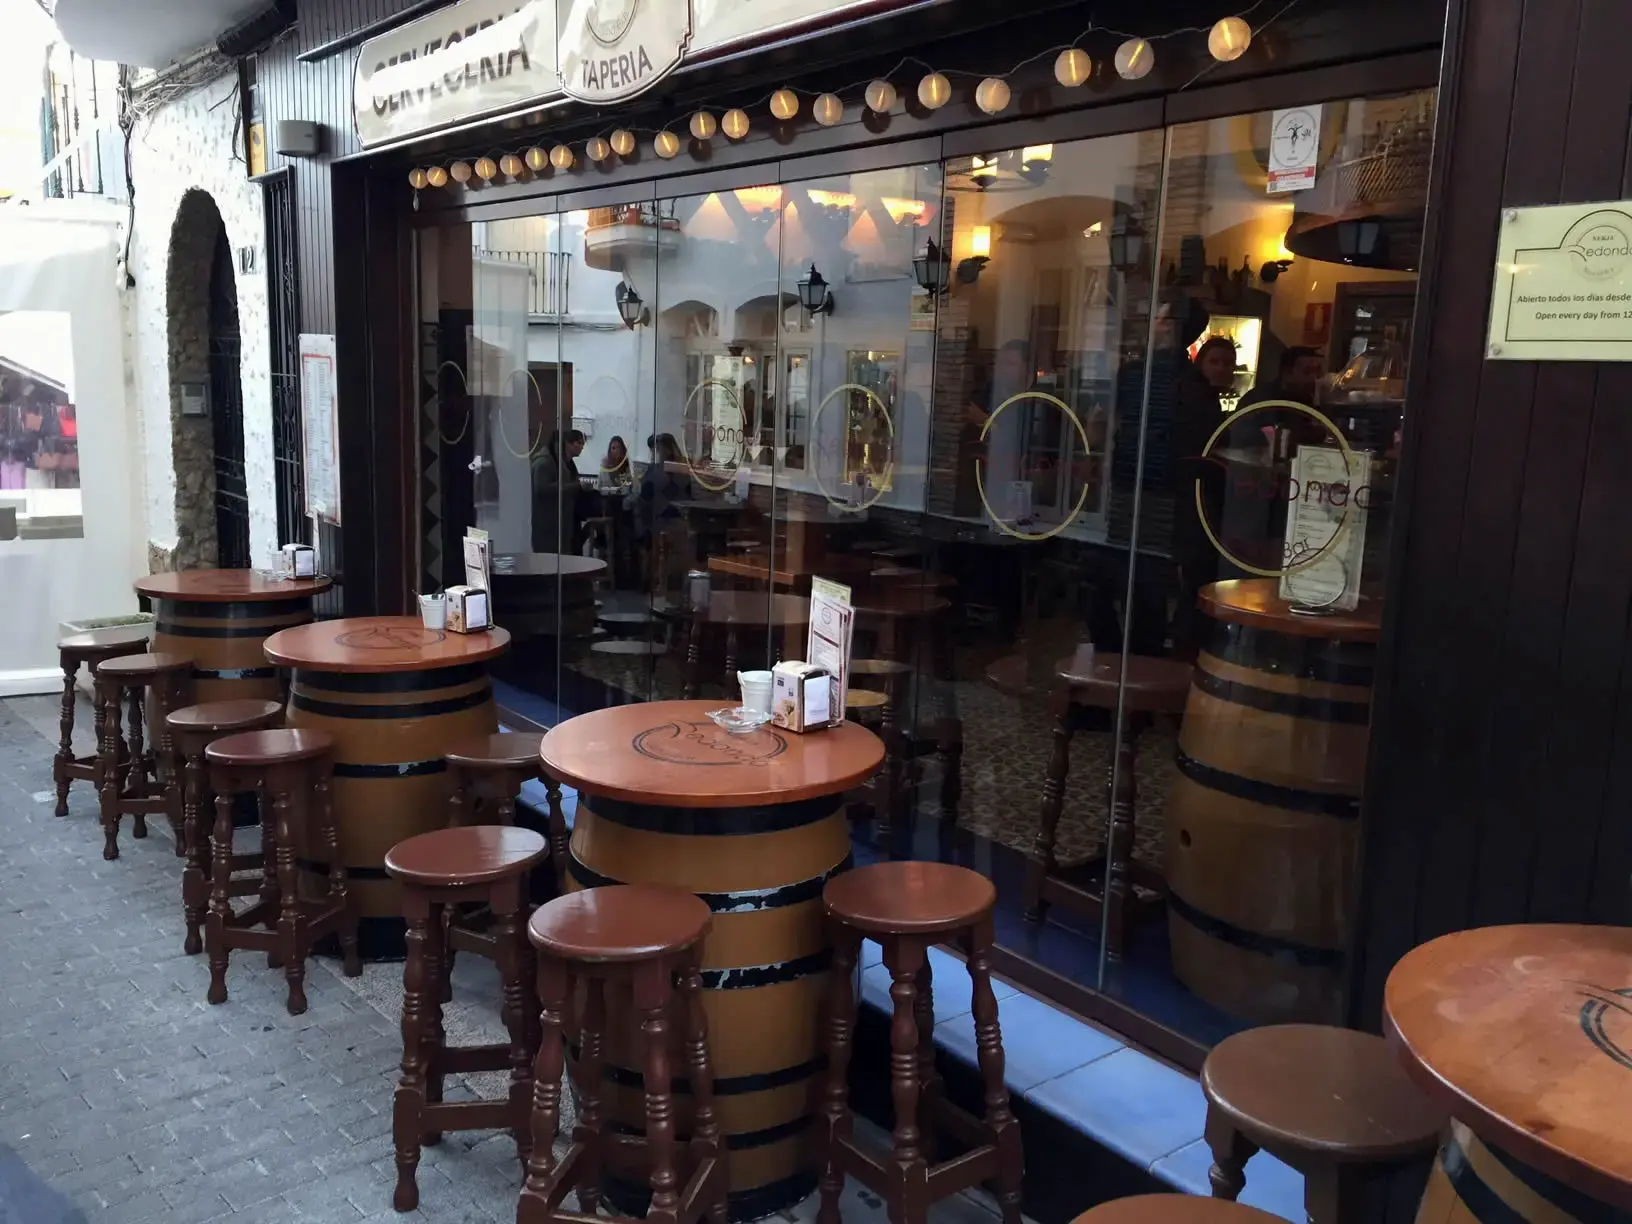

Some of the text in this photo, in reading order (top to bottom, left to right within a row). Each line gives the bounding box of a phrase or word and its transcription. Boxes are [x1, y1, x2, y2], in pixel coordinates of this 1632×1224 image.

[1516, 295, 1547, 304] Abierto
[1548, 294, 1571, 303] todos
[1573, 294, 1585, 303] los
[1605, 292, 1632, 302] desde
[1535, 312, 1557, 321] Open
[1558, 312, 1581, 321] every
[1583, 311, 1598, 321] day
[1599, 311, 1621, 320] from
